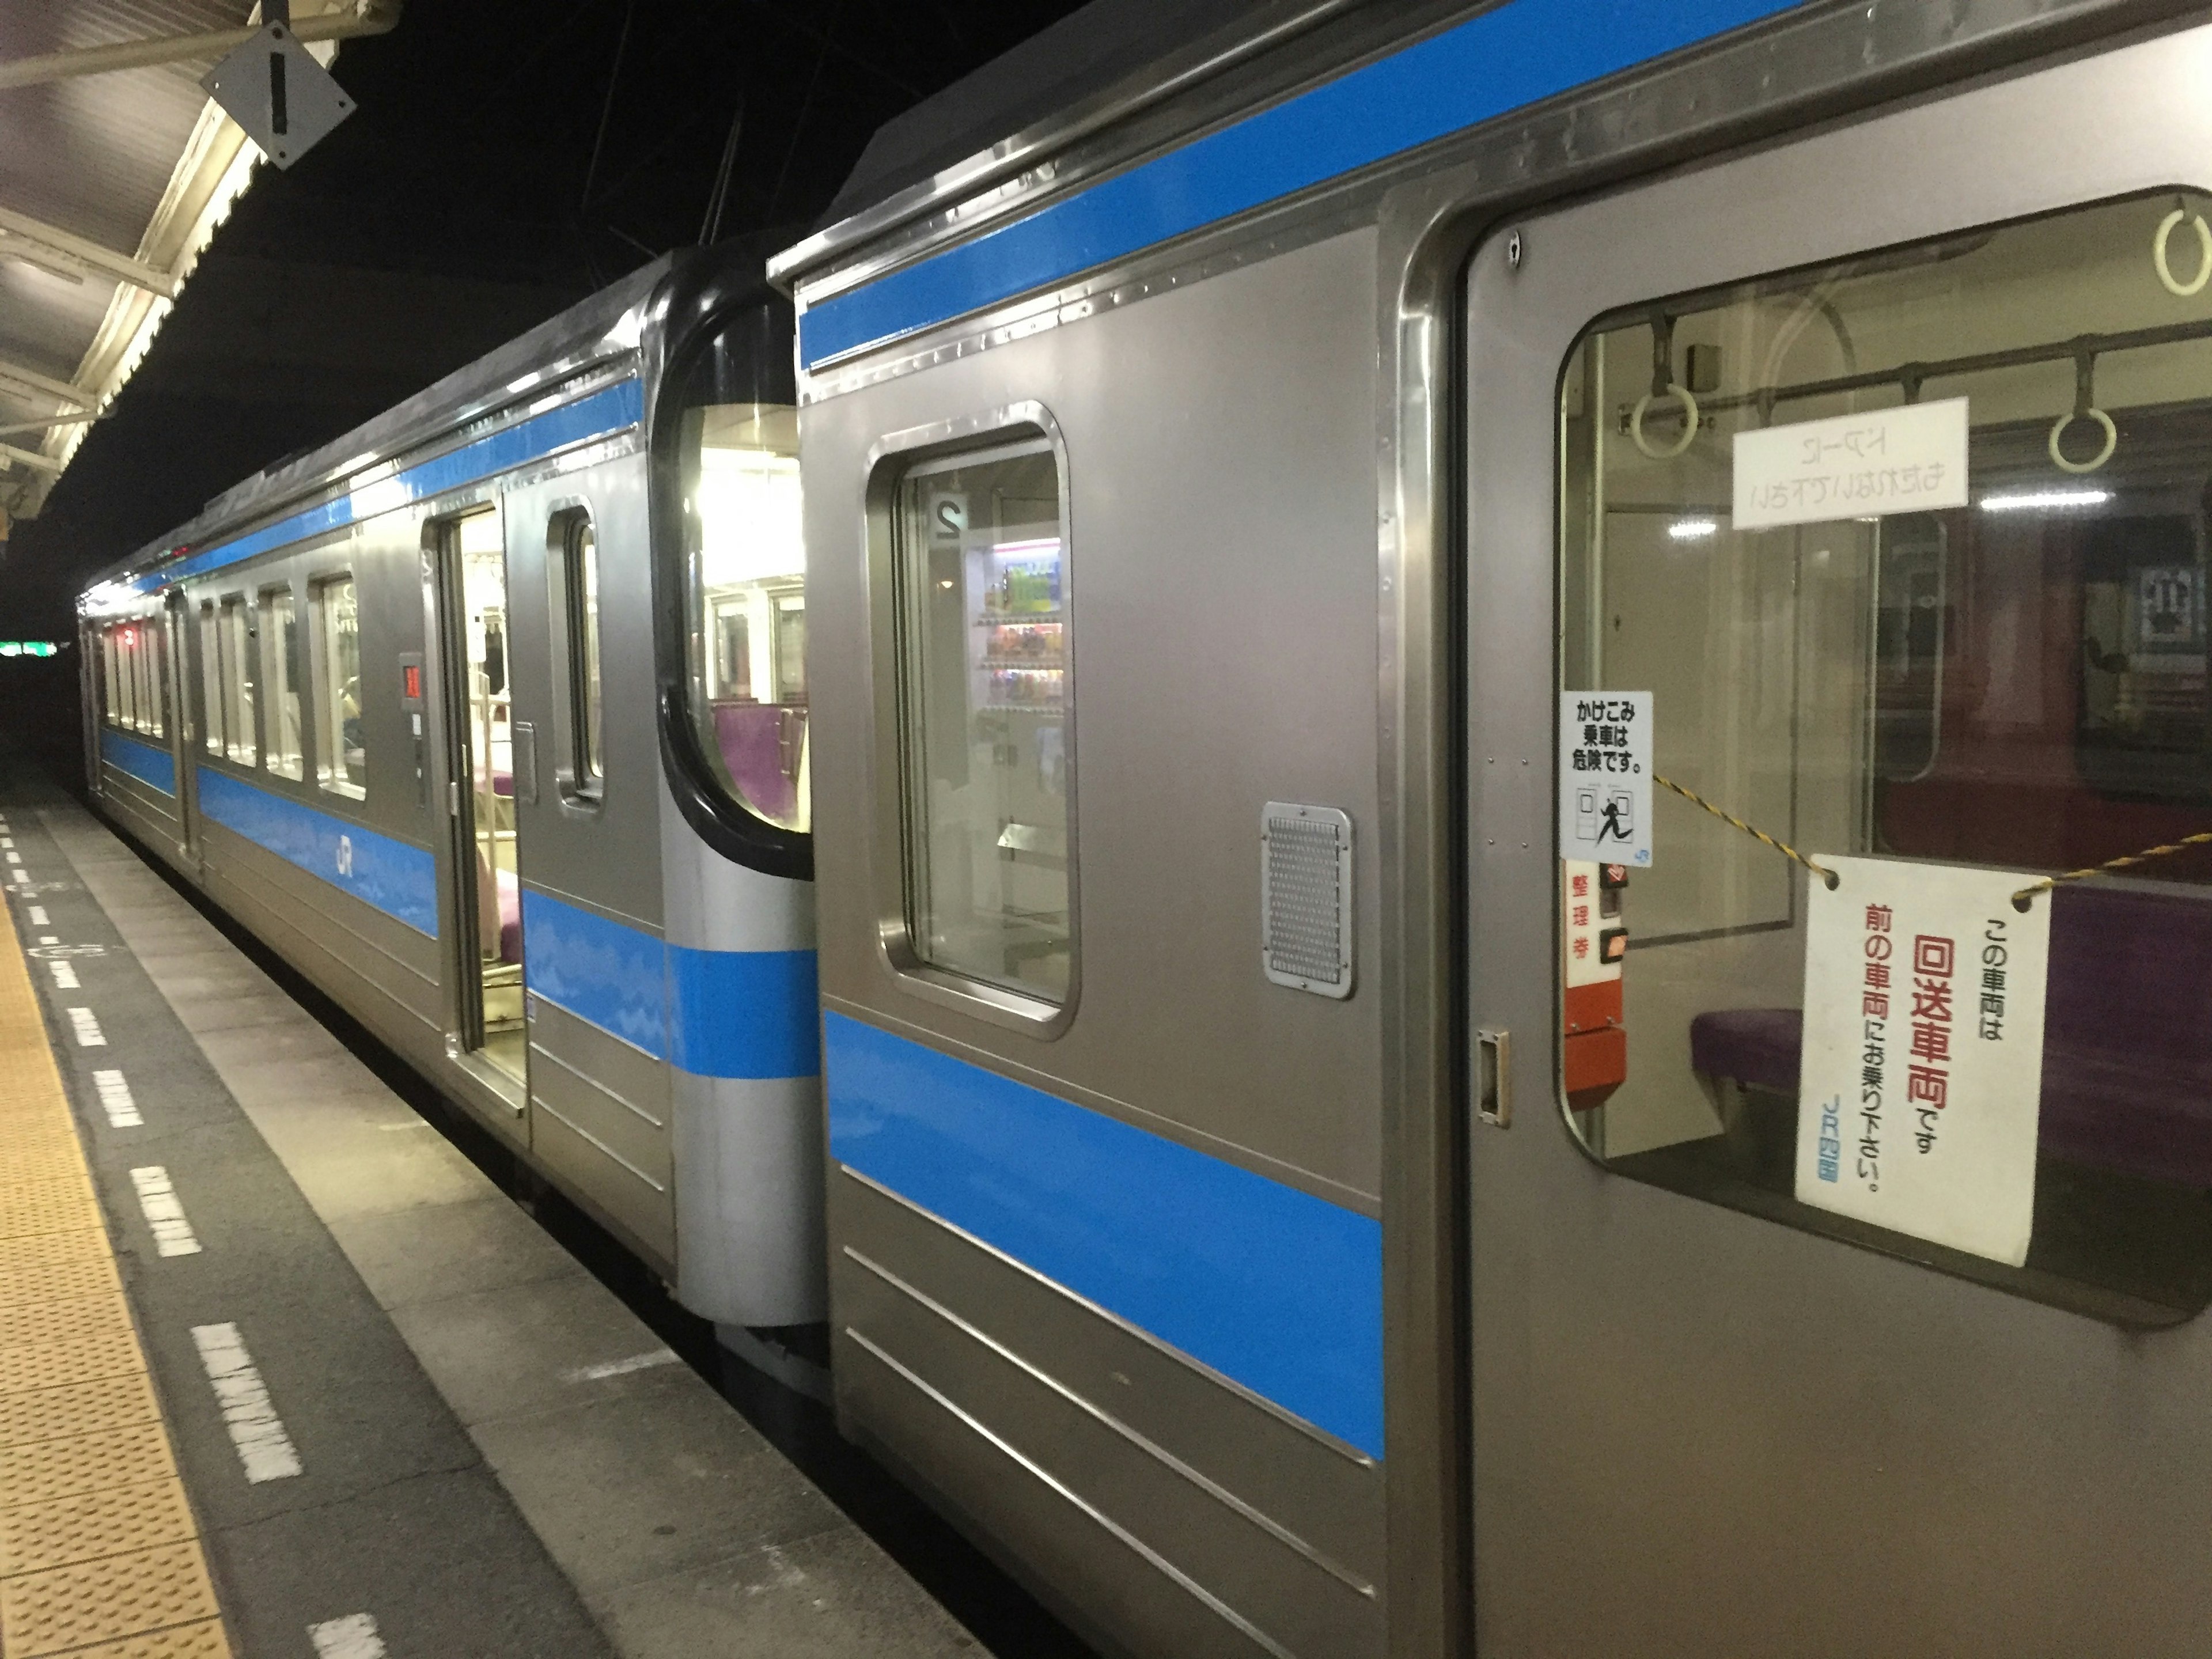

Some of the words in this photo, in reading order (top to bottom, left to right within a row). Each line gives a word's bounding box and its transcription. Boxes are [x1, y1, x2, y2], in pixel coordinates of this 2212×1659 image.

[1576, 699, 1636, 722] かけこみ
[1583, 724, 1629, 748] 乗車は
[1572, 748, 1641, 774] 危険です。
[1978, 919, 2008, 1041] この車両は
[1907, 934, 1956, 1154] 回送車両です
